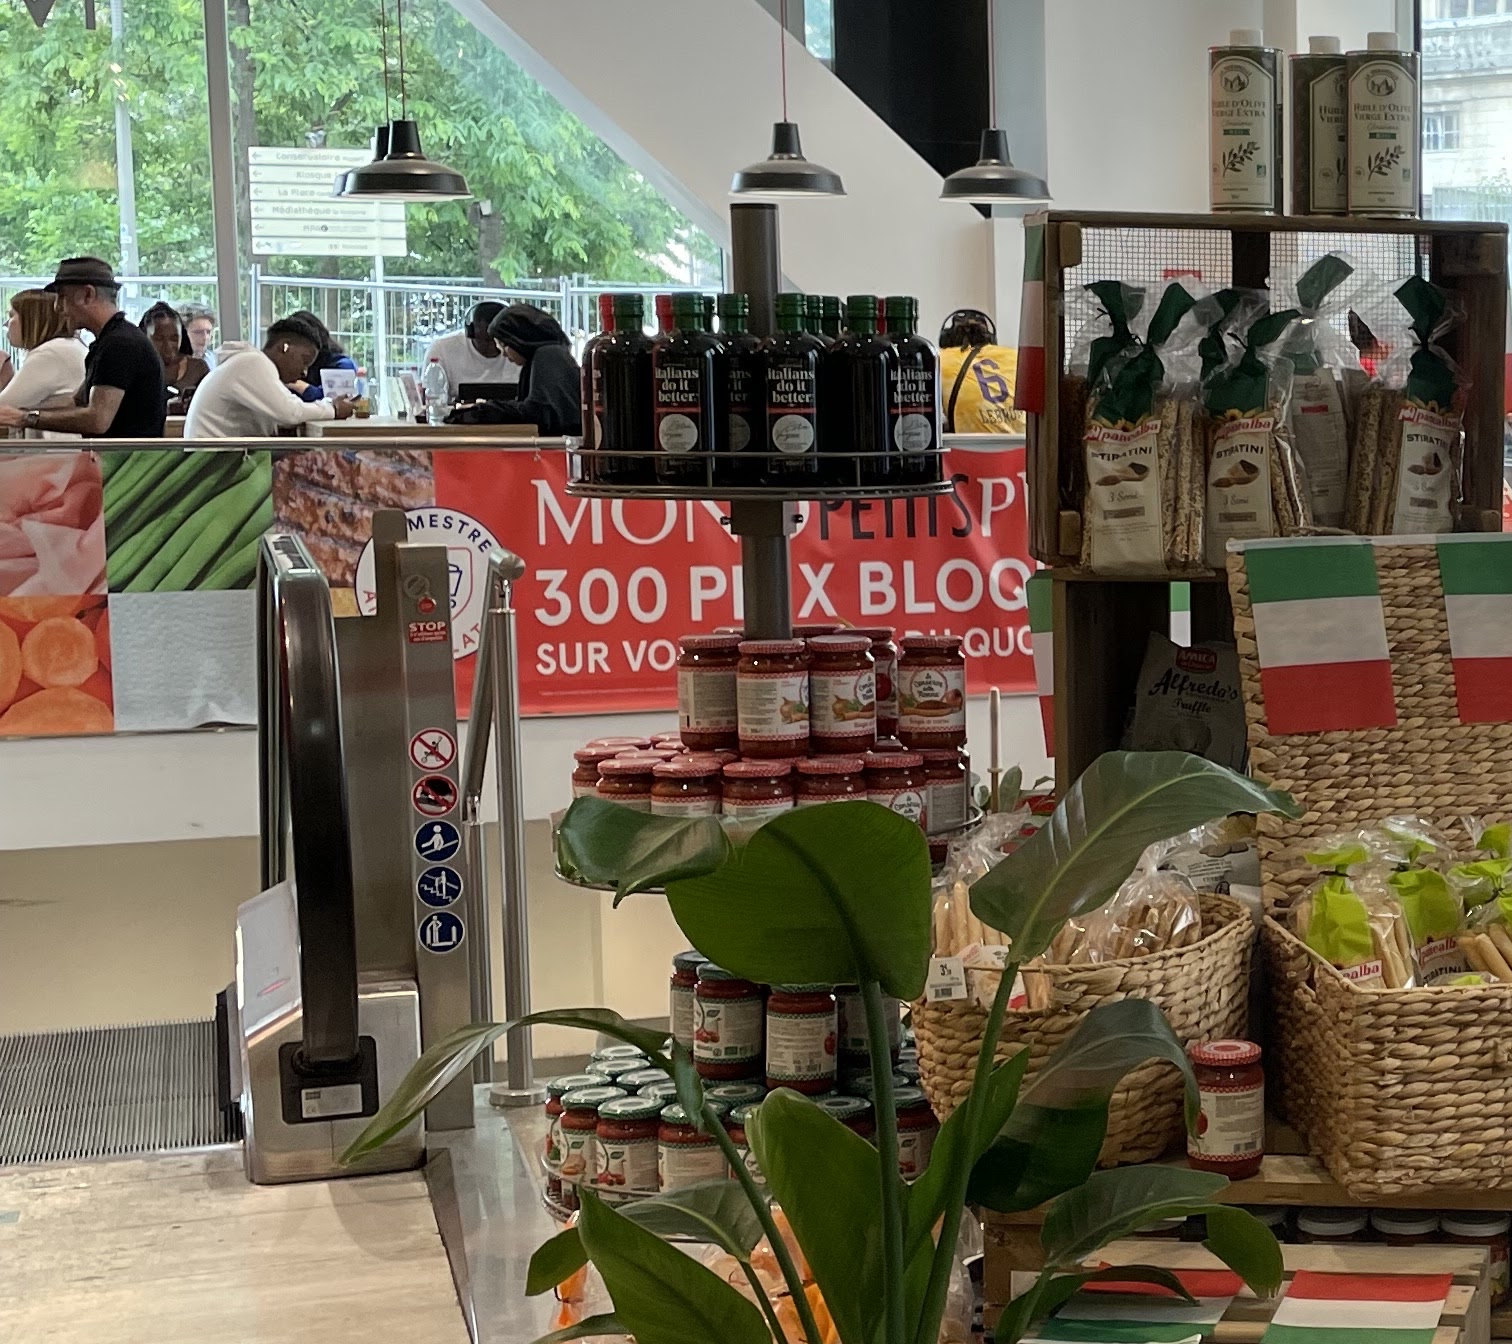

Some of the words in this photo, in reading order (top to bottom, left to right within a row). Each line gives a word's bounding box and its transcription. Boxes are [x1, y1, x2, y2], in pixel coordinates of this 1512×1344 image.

[973, 358, 1009, 404] 6
[534, 566, 667, 626] 300
[859, 558, 1031, 617] BLOQ
[409, 621, 446, 632] STOP
[536, 641, 611, 675] SUR
[622, 640, 676, 672] VO
[1148, 667, 1238, 701] Alfredo's
